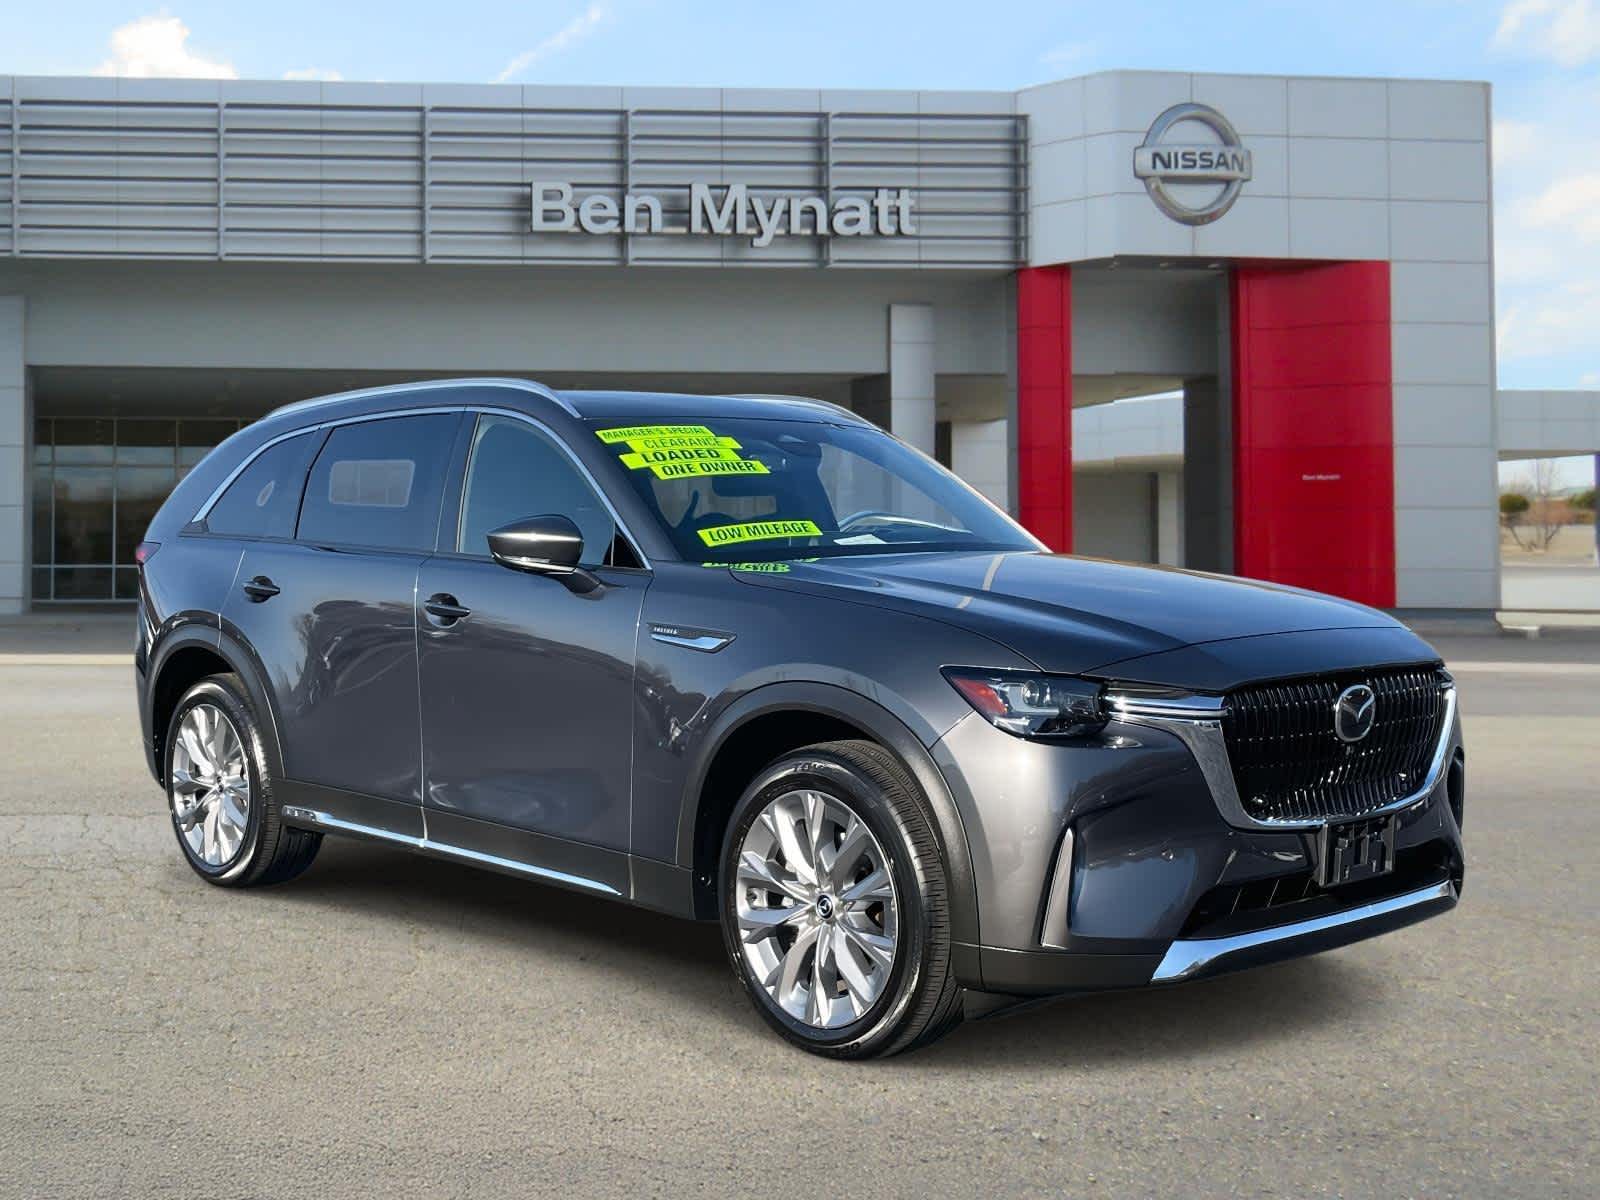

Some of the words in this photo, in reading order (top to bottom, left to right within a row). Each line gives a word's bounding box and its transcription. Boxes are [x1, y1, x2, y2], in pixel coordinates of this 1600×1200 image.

[1151, 151, 1244, 172] NISSAN
[530, 181, 664, 235] Ben
[690, 182, 917, 248] Mynatt
[602, 428, 665, 440] MANAGER'S
[666, 427, 706, 436] SPECIAL
[643, 437, 721, 449] CLEARANCE
[641, 449, 720, 463] LOADED
[662, 465, 697, 476] ONE
[700, 462, 756, 473] OWNER
[708, 528, 743, 542] LOW
[746, 522, 810, 537] MILEAGE
